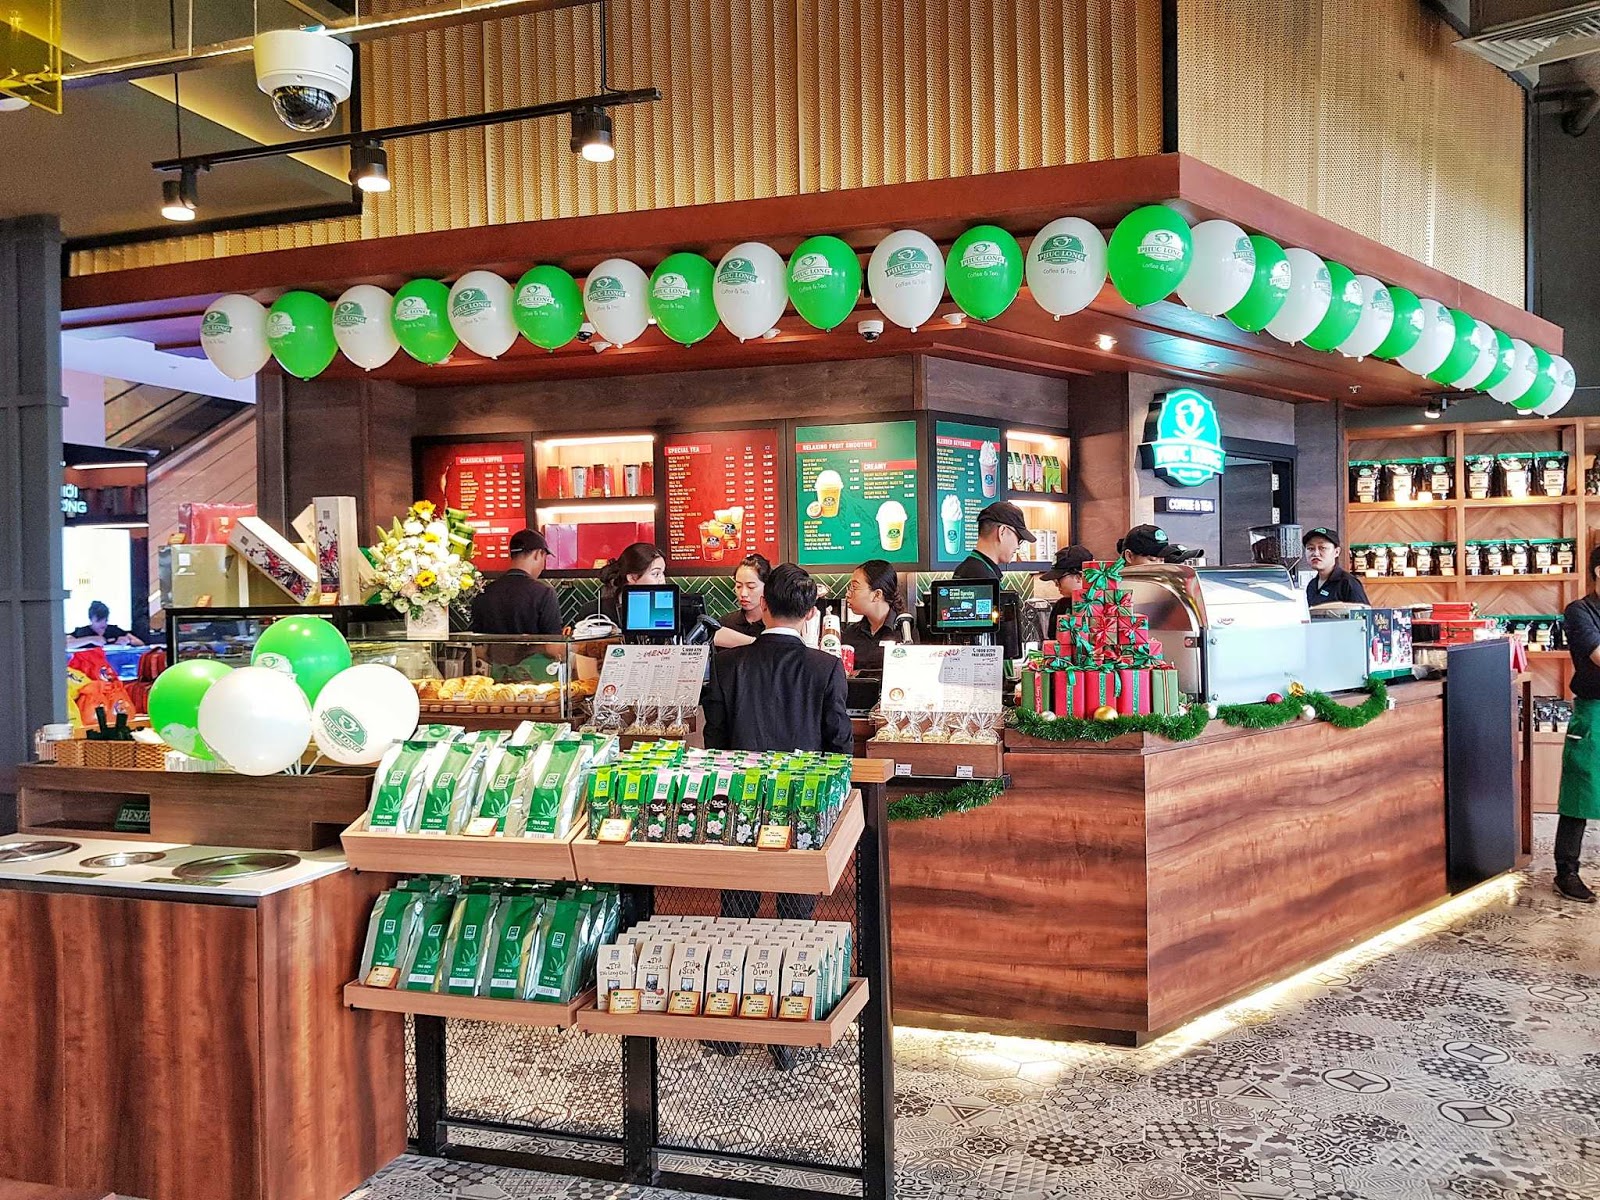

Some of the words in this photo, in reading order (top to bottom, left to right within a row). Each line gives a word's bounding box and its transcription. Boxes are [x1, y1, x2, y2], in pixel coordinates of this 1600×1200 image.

[1061, 251, 1085, 261] LONG
[1163, 247, 1182, 257] LONG
[983, 255, 1003, 263] LONG
[810, 267, 830, 275] LONG
[910, 262, 931, 271] LONG
[734, 272, 755, 282] LONG
[604, 289, 625, 298] LONG
[669, 288, 689, 296] LONG
[460, 456, 485, 464] CLASSICAL
[1168, 499, 1194, 511] COFFEE
[643, 648, 671, 658] MENU
[929, 648, 960, 658] MENU
